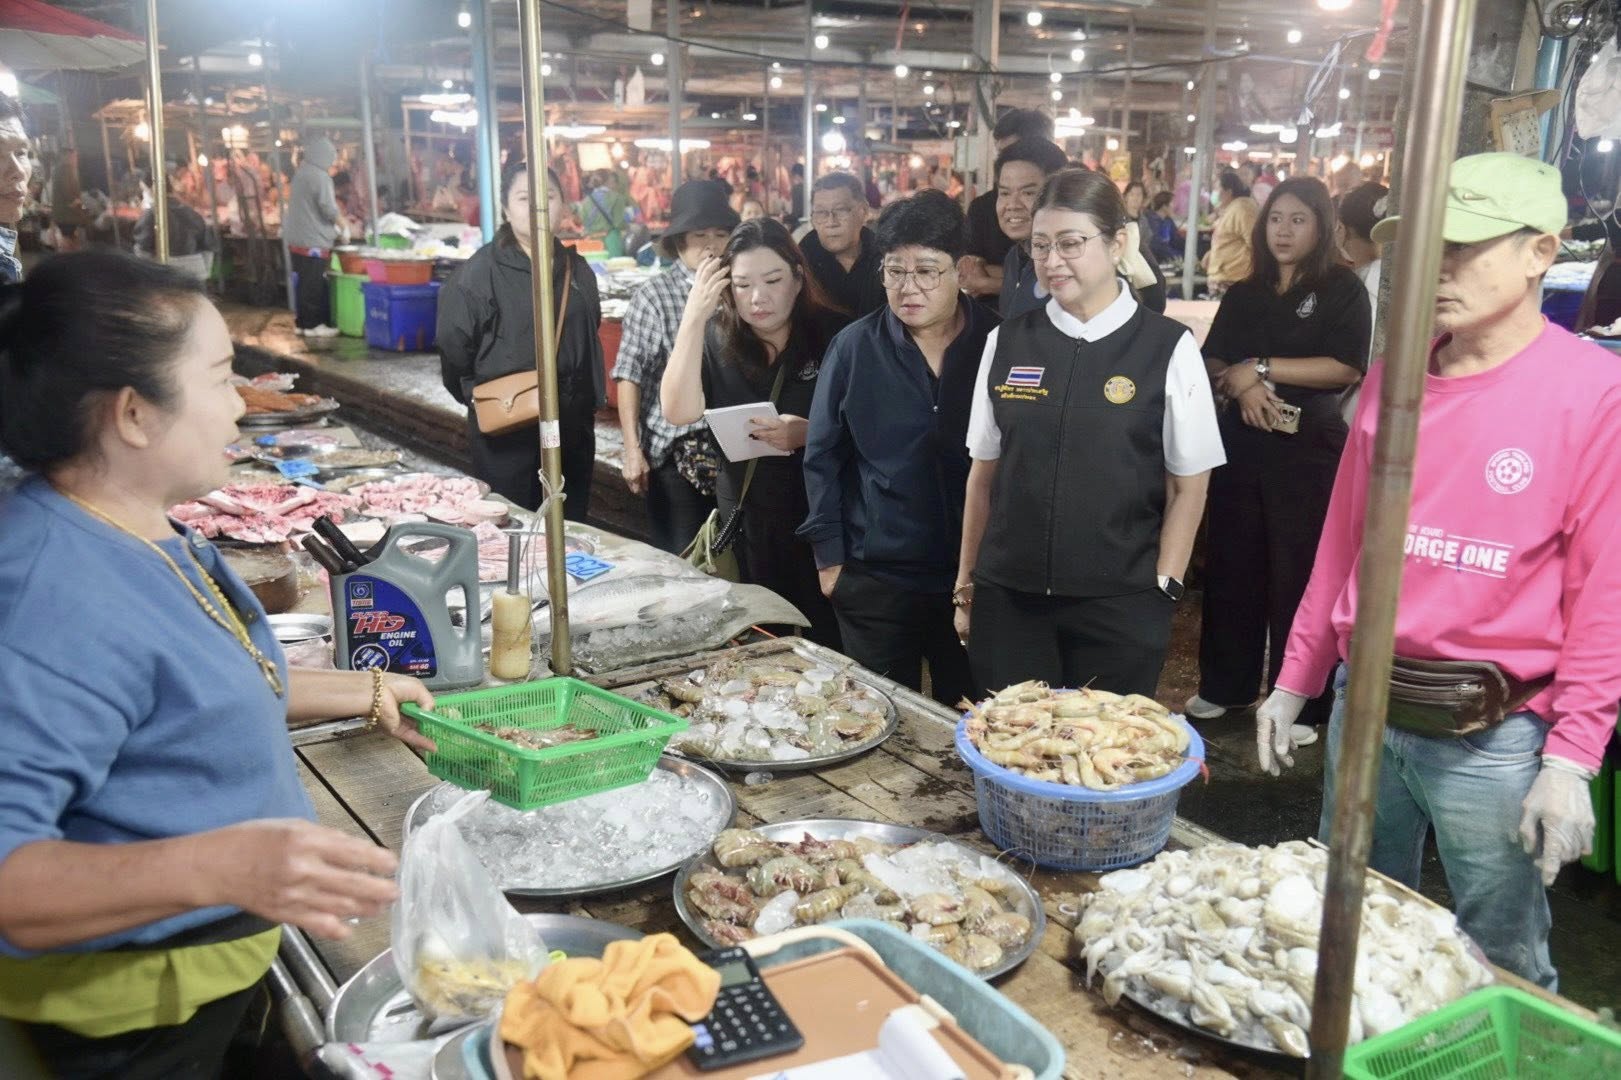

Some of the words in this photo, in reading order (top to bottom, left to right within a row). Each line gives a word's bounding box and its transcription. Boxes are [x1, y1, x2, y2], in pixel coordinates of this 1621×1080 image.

[1403, 534, 1458, 563] ORCE
[1461, 544, 1510, 573] ONE
[380, 631, 417, 640] ENGINE
